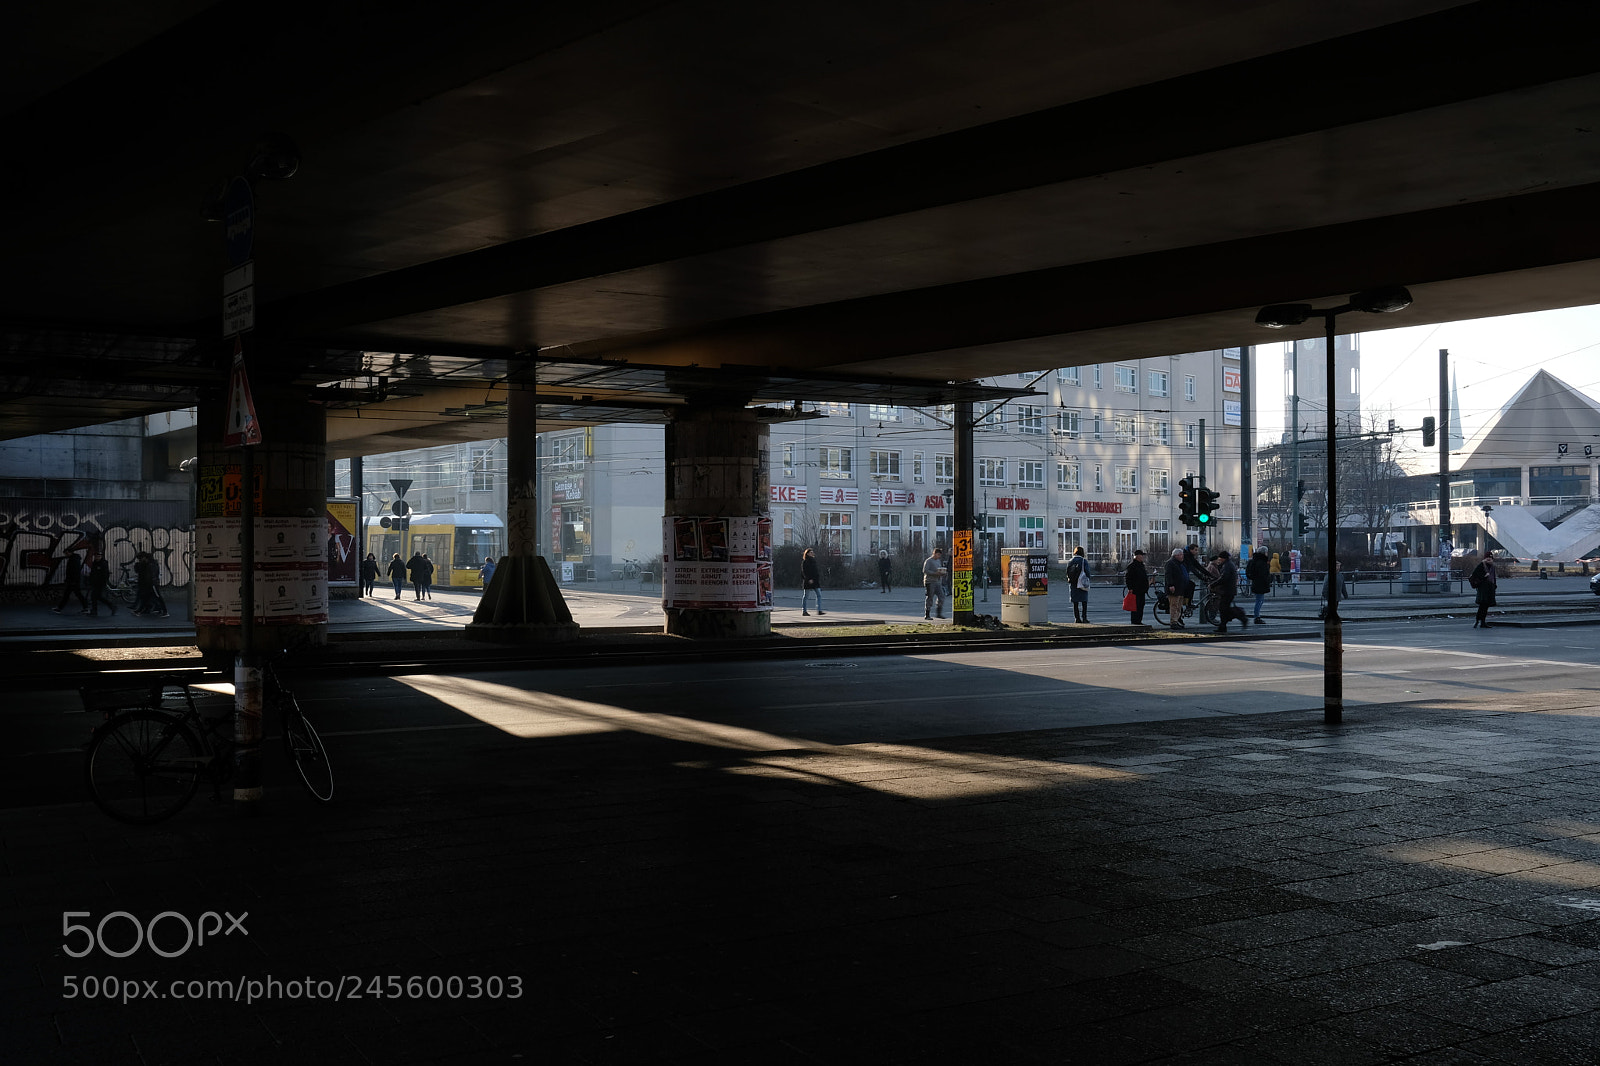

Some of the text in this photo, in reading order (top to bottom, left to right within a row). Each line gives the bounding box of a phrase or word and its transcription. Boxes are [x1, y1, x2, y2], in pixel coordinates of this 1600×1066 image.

[565, 488, 582, 500] Kebab
[924, 495, 945, 509] ASIA
[1075, 501, 1123, 514] SUPERMARKET
